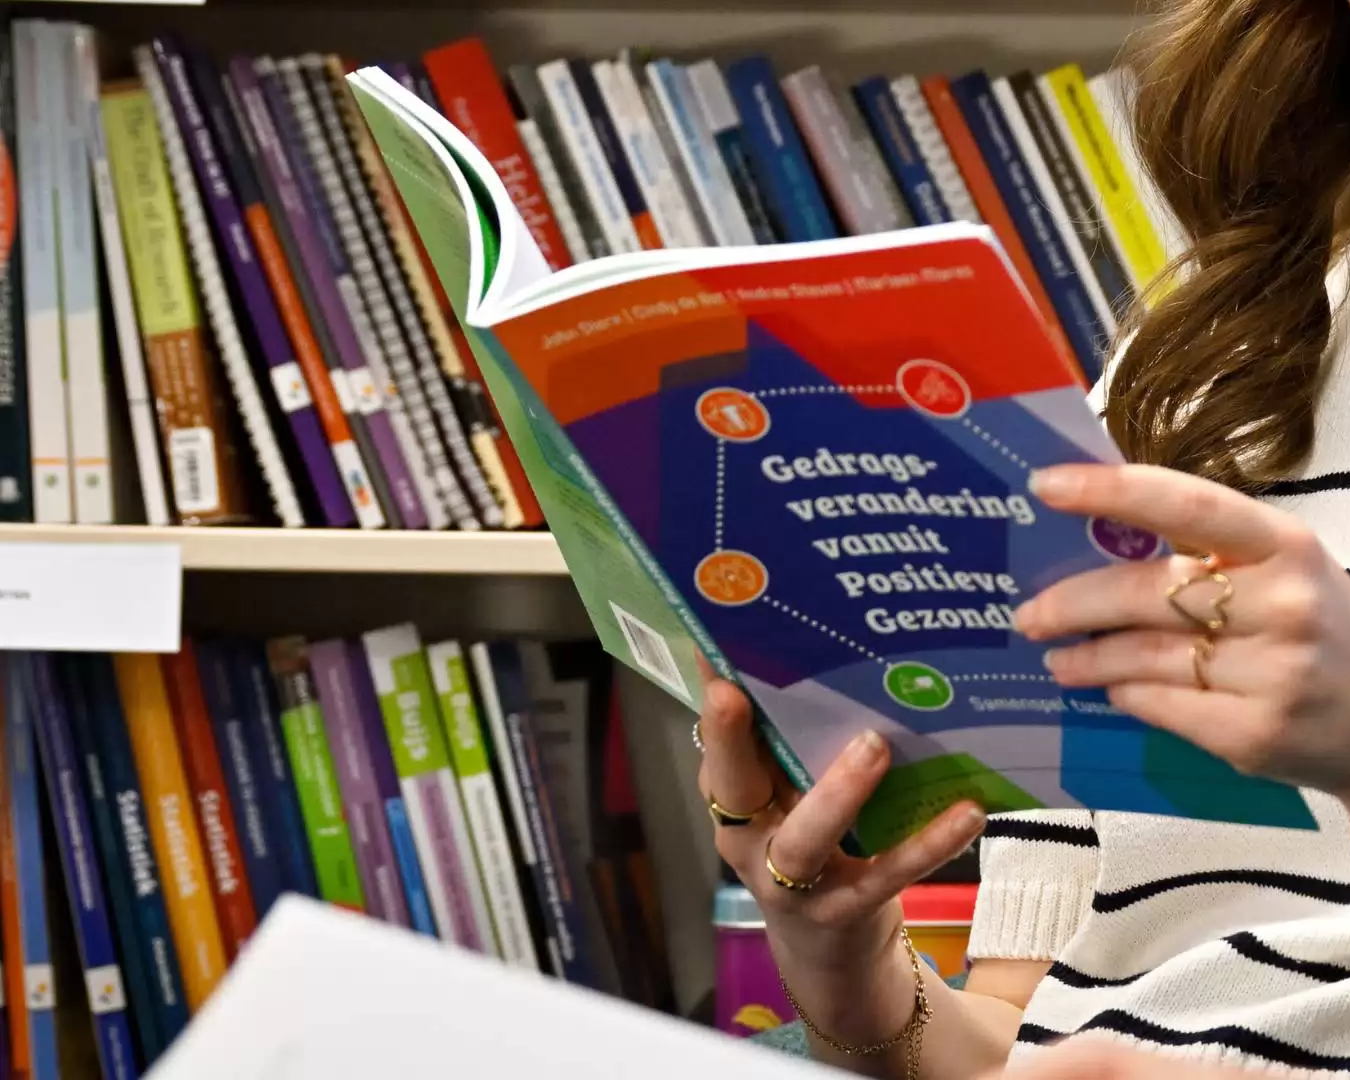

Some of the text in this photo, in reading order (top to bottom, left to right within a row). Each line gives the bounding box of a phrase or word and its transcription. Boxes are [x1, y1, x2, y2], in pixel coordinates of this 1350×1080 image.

[542, 330, 577, 350] John
[761, 448, 938, 482] Gedrags-
[786, 488, 1036, 525] verandering
[568, 452, 680, 606] Gedragsverandering
[678, 606, 718, 656] vanuit
[812, 524, 950, 559] vanuit
[836, 563, 1020, 597] Positieve
[396, 691, 430, 762] Buijs
[449, 691, 477, 751] Buijs
[968, 695, 1066, 714] Samenspel
[115, 789, 158, 898] Statistiek
[159, 793, 199, 899] Statistiek
[197, 789, 239, 895] Statistiek
